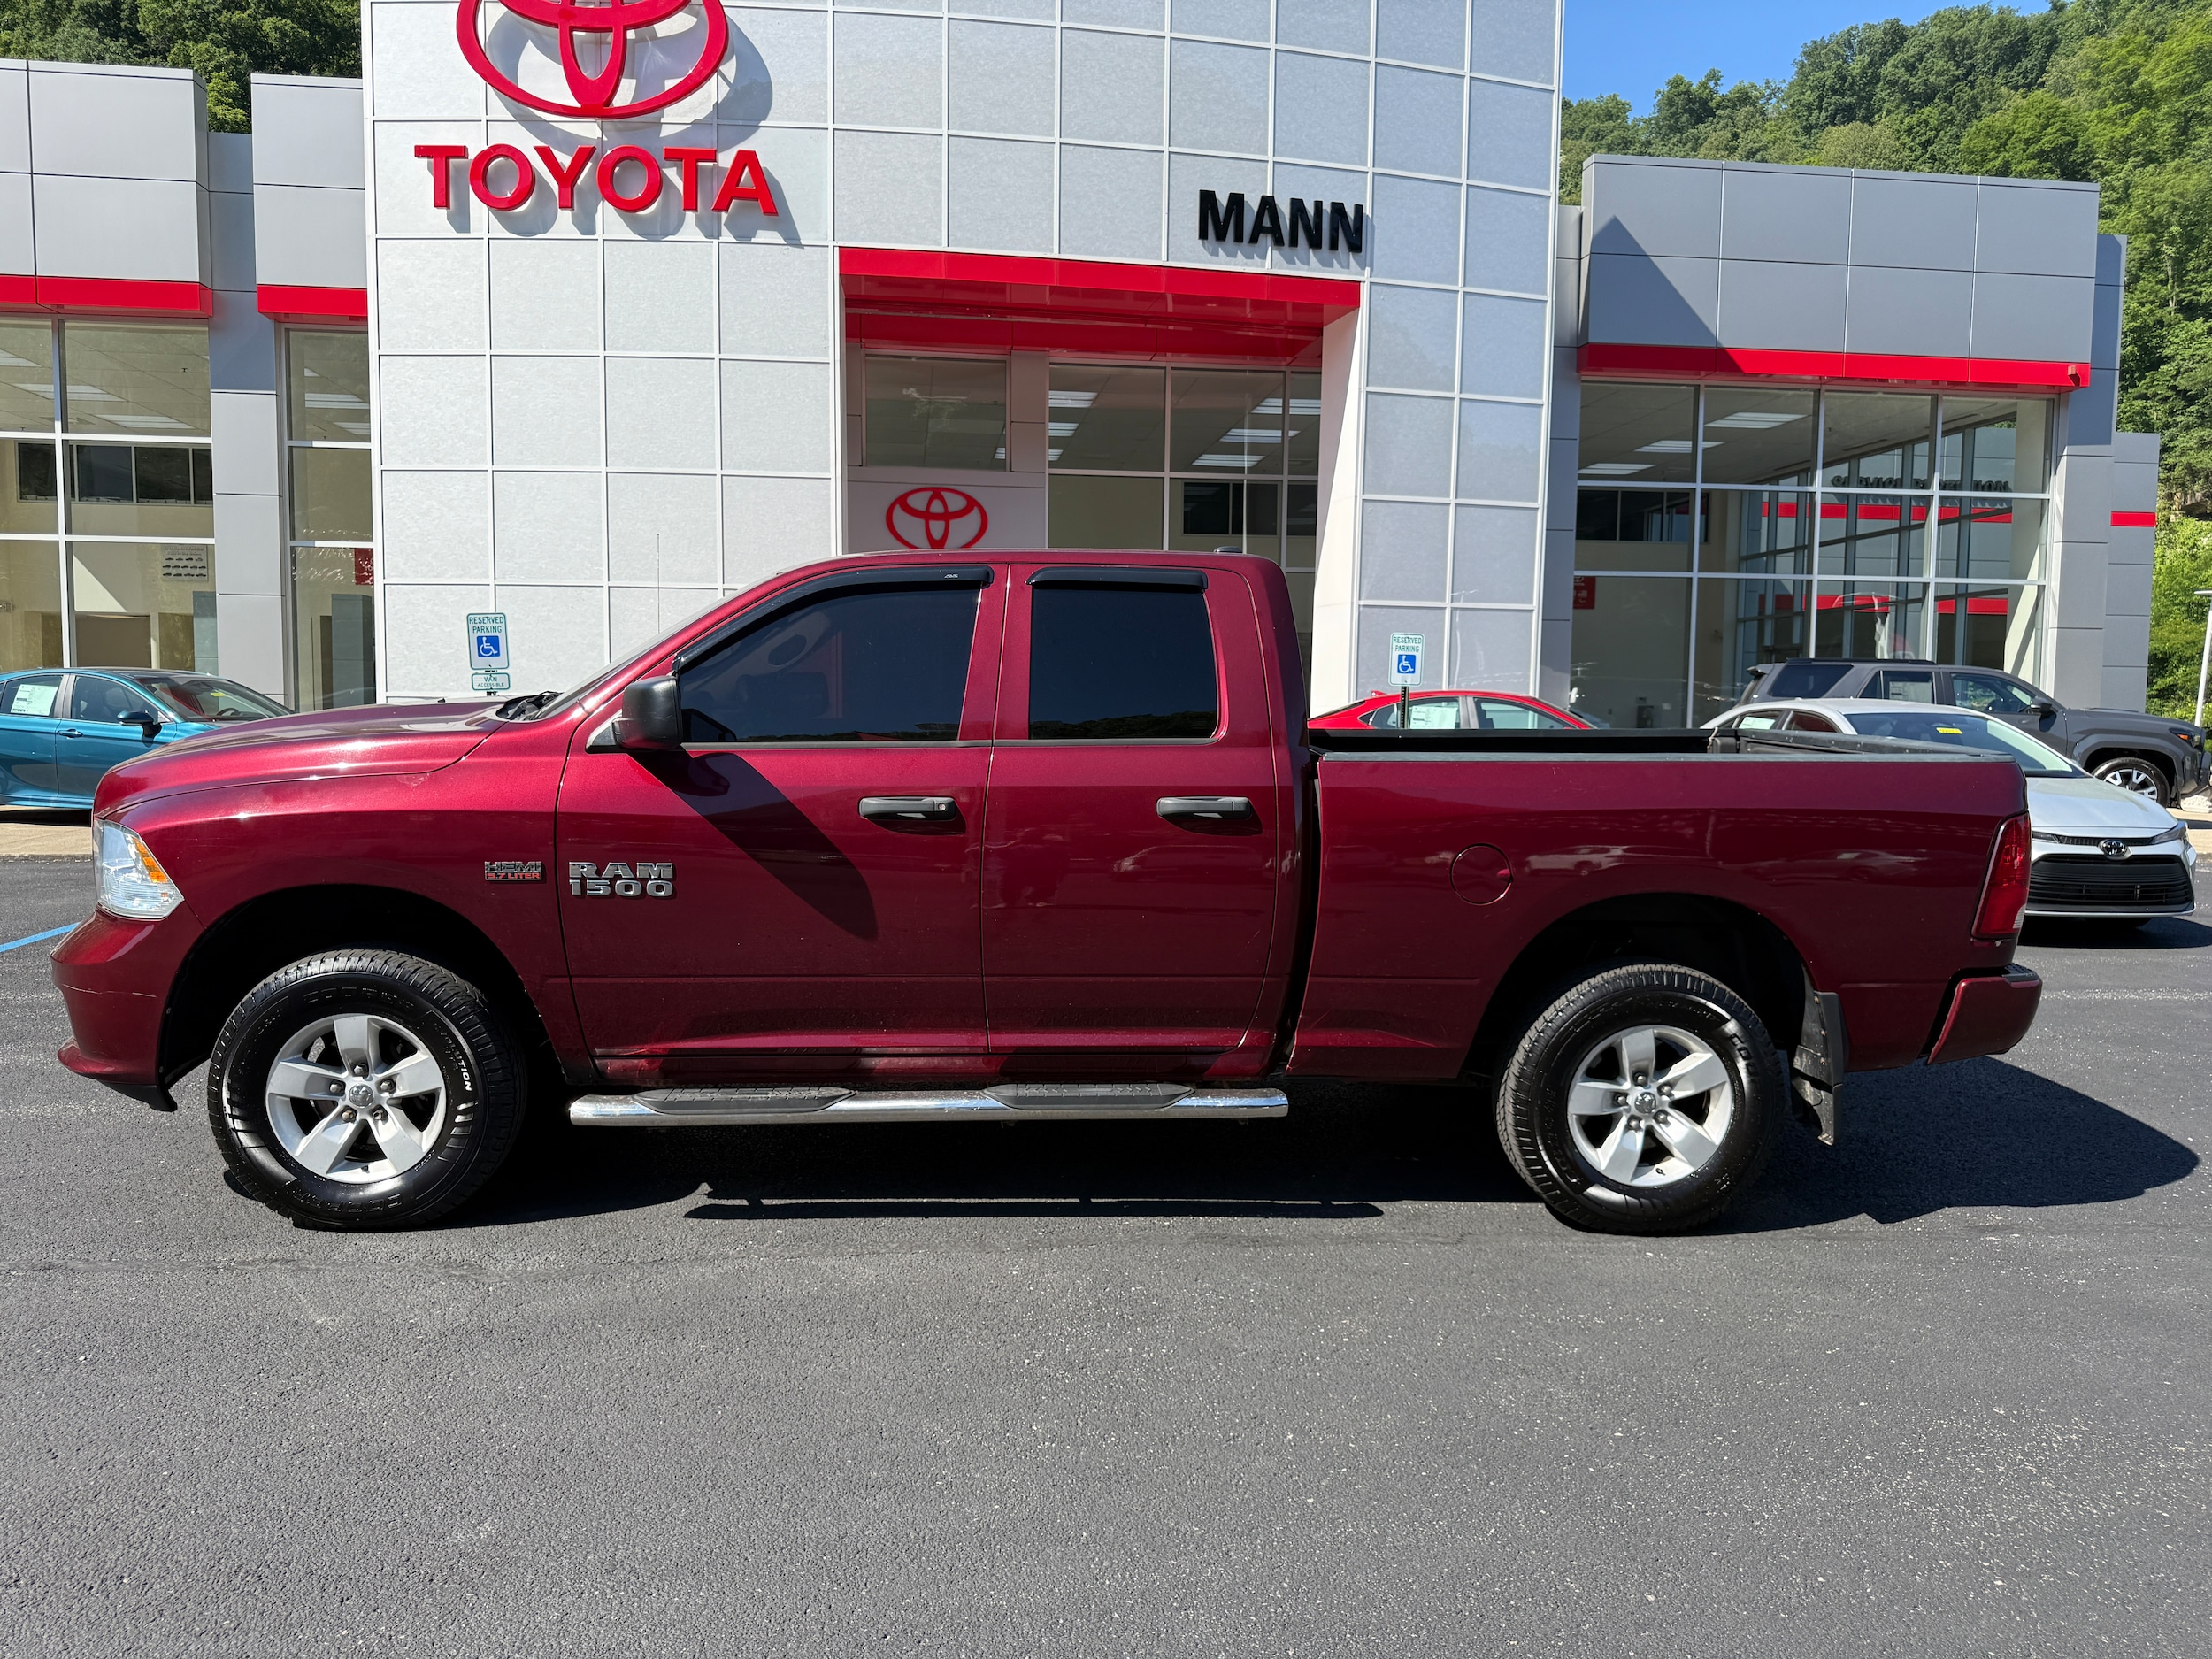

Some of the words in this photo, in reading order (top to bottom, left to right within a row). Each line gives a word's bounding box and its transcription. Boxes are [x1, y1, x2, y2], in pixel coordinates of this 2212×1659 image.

[414, 143, 779, 217] TOYOTA
[1198, 189, 1363, 253] MANN
[469, 616, 504, 625] RESERVED
[484, 861, 541, 872] HEMI
[569, 861, 673, 879] RAM
[569, 879, 673, 897] 1500
